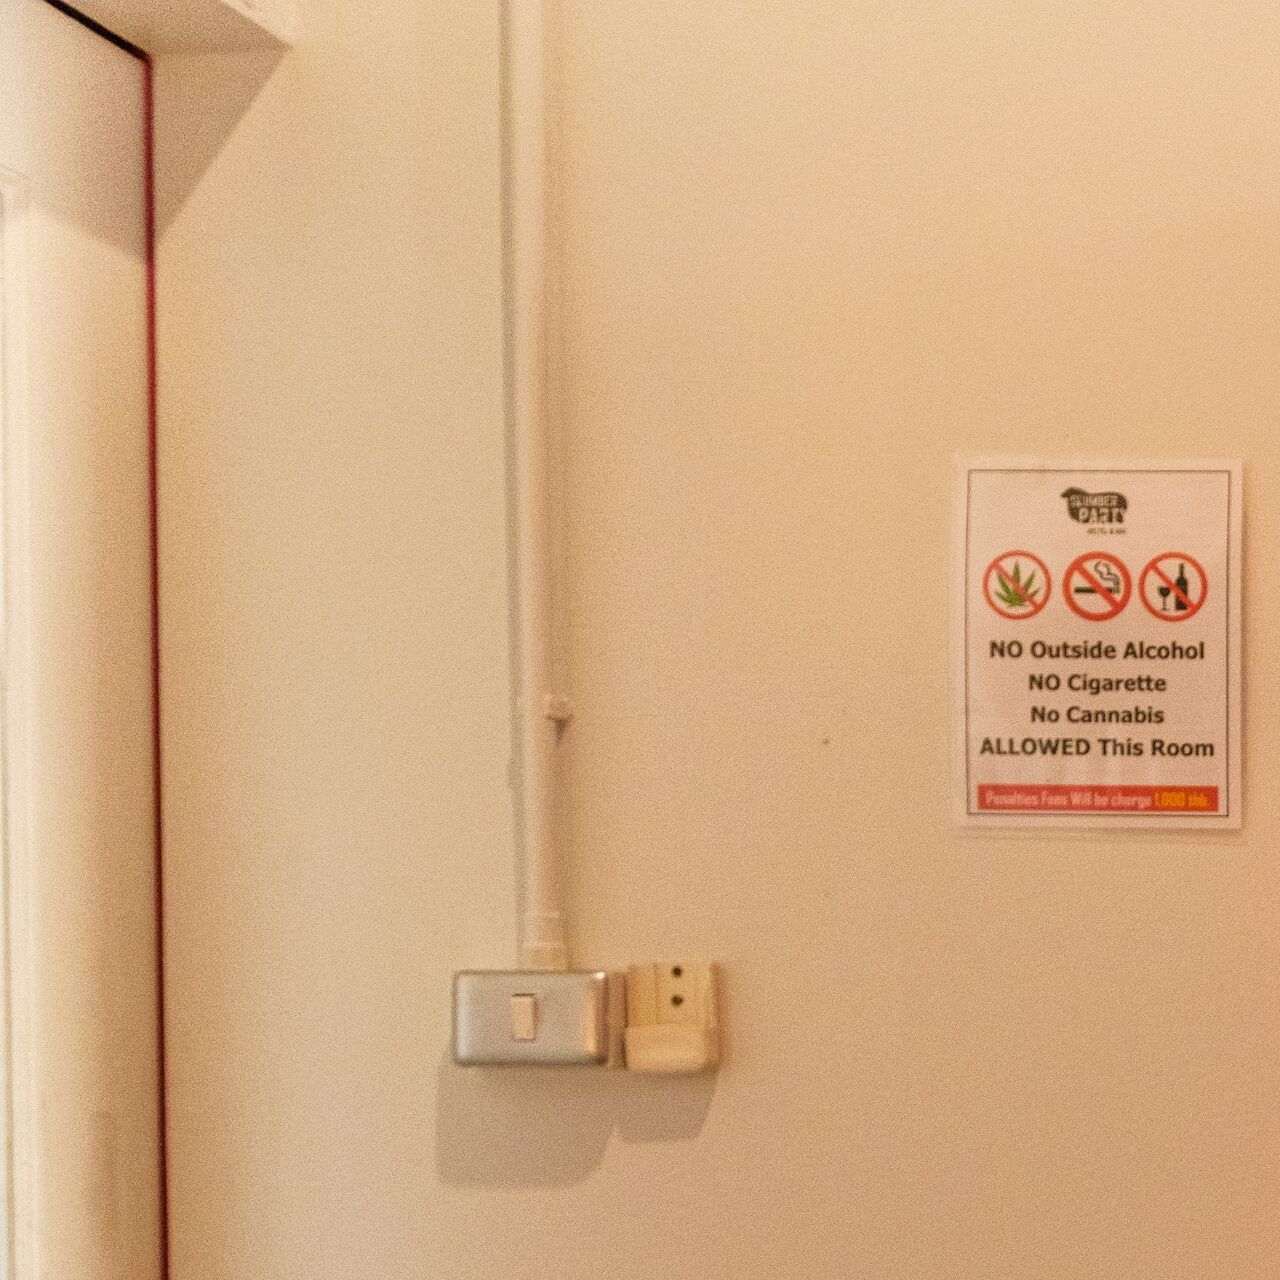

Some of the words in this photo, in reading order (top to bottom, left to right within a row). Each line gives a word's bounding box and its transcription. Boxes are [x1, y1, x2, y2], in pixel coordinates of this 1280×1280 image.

[989, 640, 1023, 660] NO
[1029, 640, 1117, 660] Outside
[1122, 641, 1206, 660] Alcohol
[1028, 673, 1061, 692] NO
[1066, 673, 1167, 695] Cigarette
[1030, 705, 1060, 724] No
[1066, 705, 1165, 725] Cannabis
[980, 737, 1091, 756] ALLOWED
[1097, 738, 1145, 757] This
[1150, 738, 1216, 757] Room
